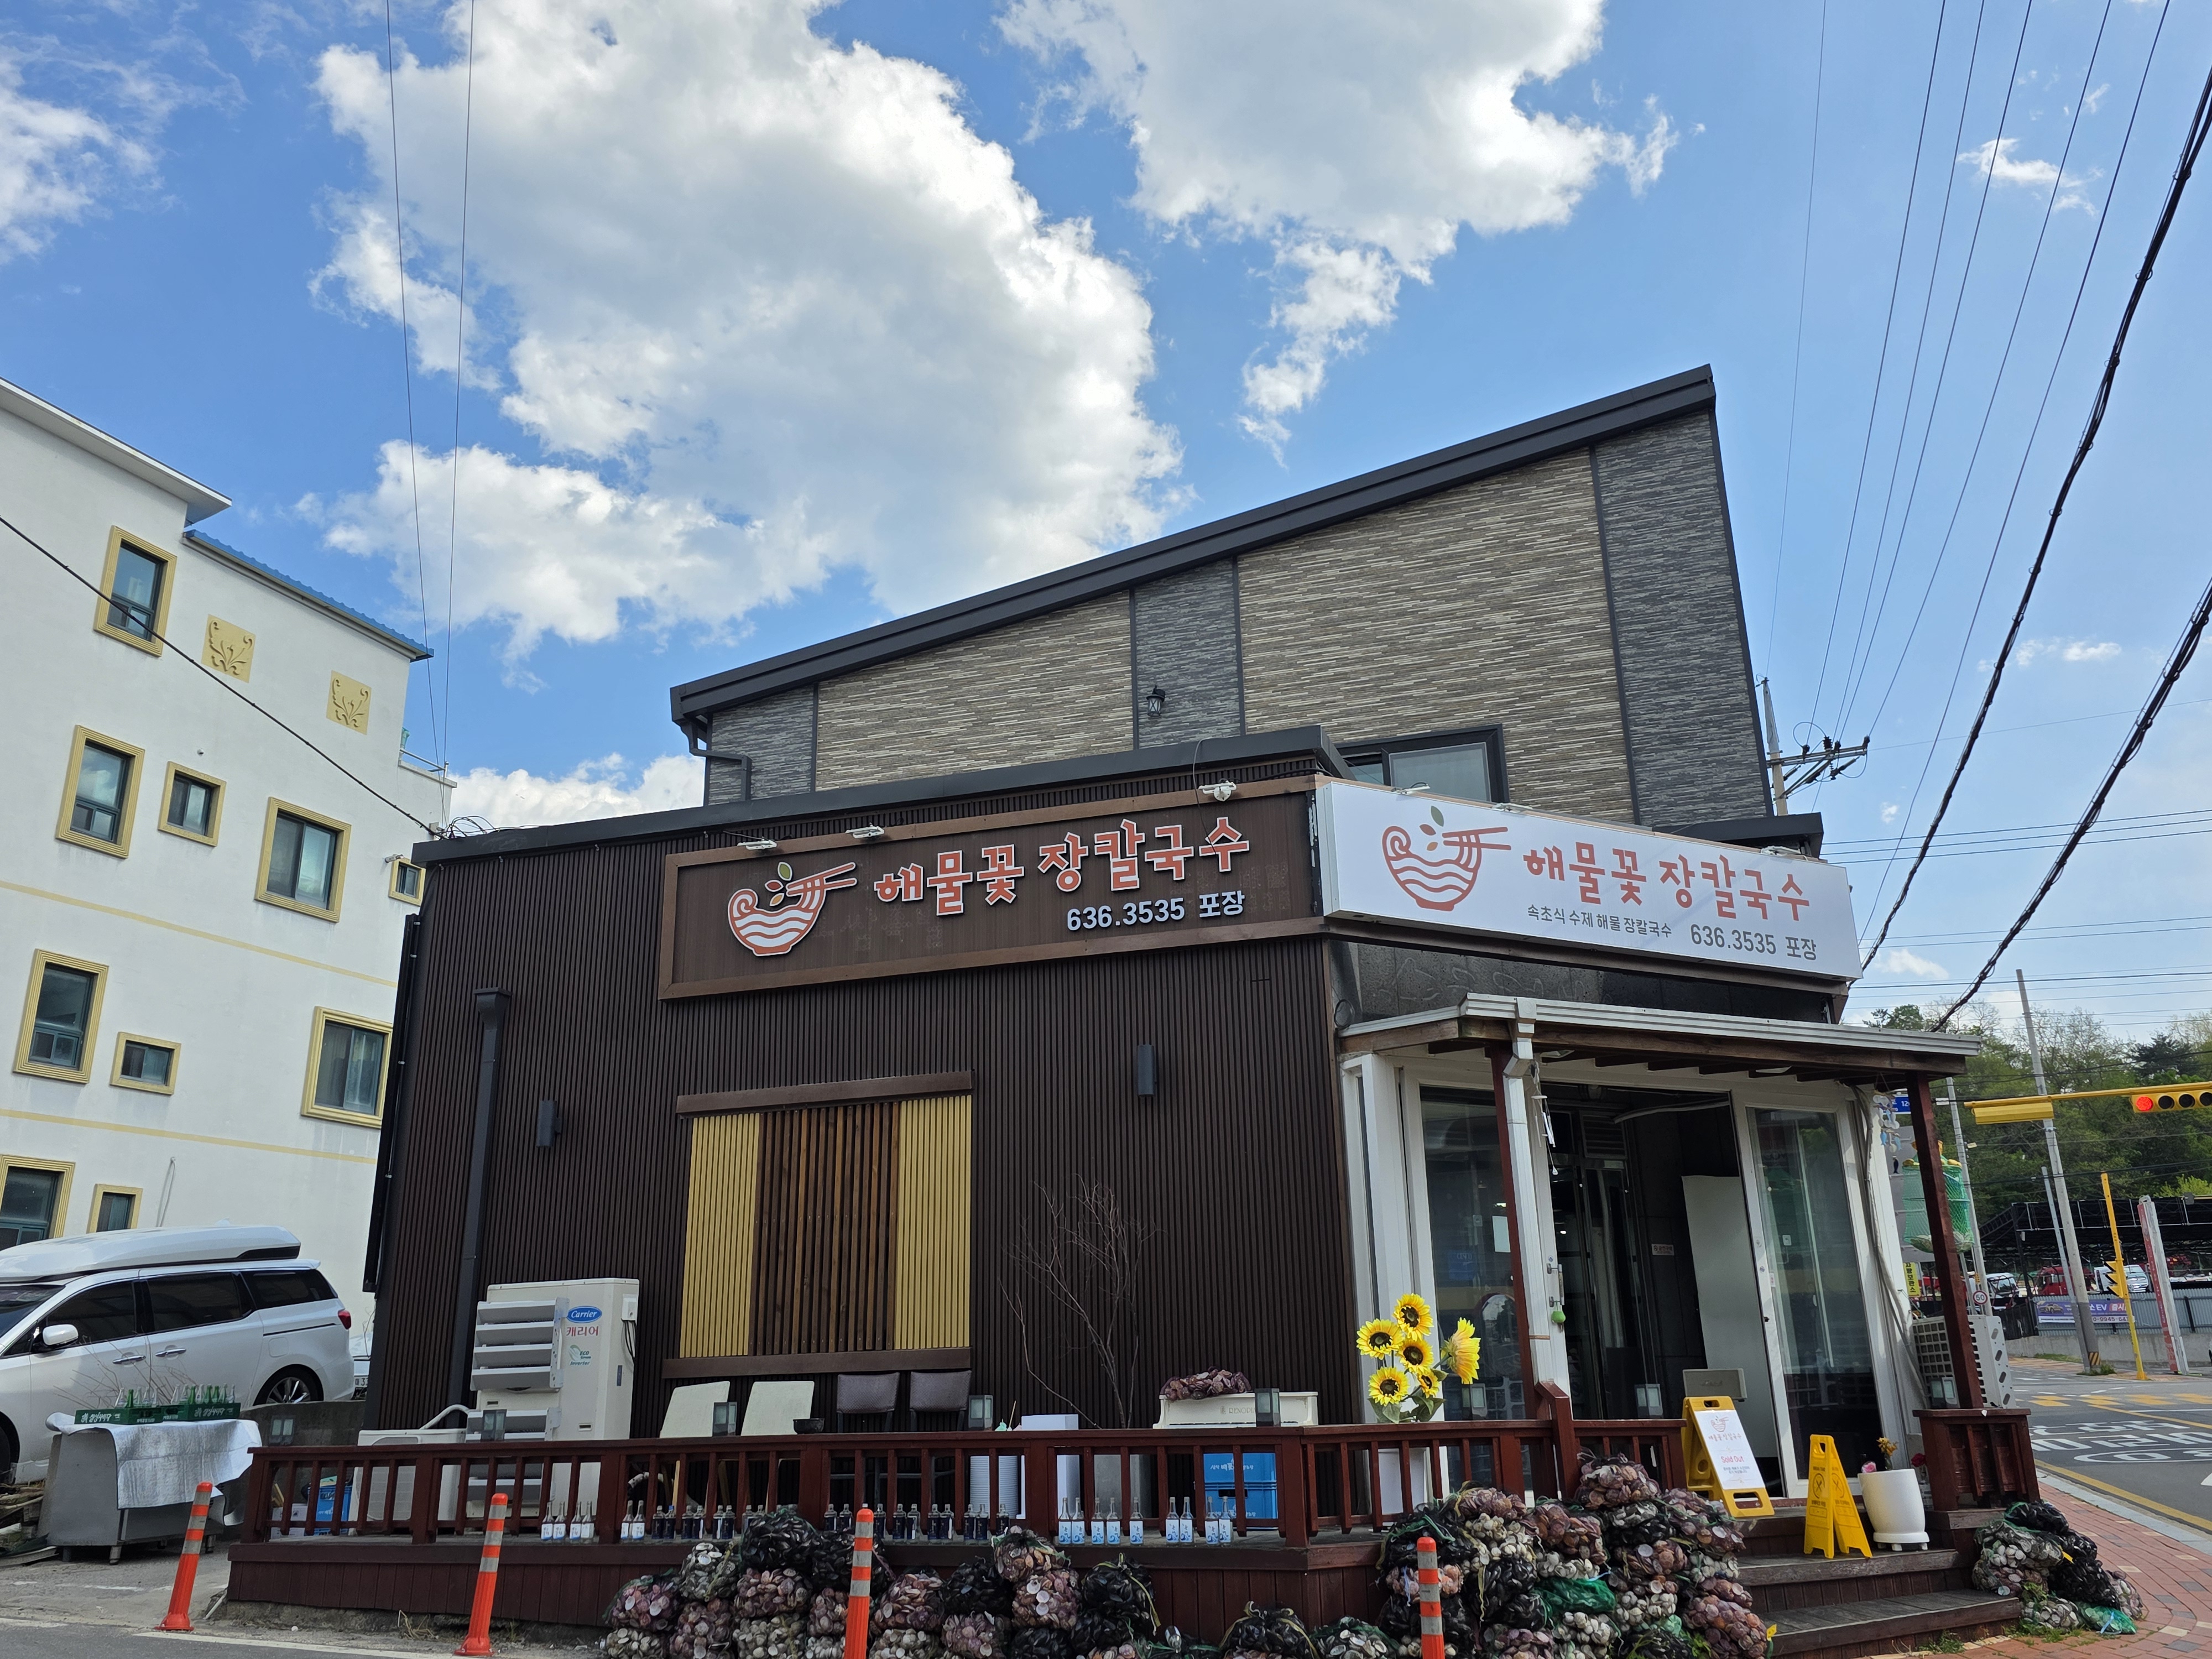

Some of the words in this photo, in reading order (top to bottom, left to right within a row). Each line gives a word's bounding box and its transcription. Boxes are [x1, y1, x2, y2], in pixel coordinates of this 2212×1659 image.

[874, 844, 1024, 916] 해물꽃
[1038, 816, 1250, 891] 장칼국수
[1523, 842, 1647, 906] 해물꽃
[1659, 854, 1810, 921] 장칼국수
[1067, 897, 1186, 931] 636.3535
[1198, 890, 1245, 919] 포장
[1527, 904, 1566, 924] 속초식
[1569, 910, 1594, 928] 수제
[1596, 913, 1621, 933] 해물
[1623, 916, 1672, 938] 장칼국수
[1690, 924, 1777, 955] 636.3535
[1786, 935, 1817, 961] 포장
[566, 1326, 599, 1337] 캐리어
[571, 1310, 598, 1318] Carrier
